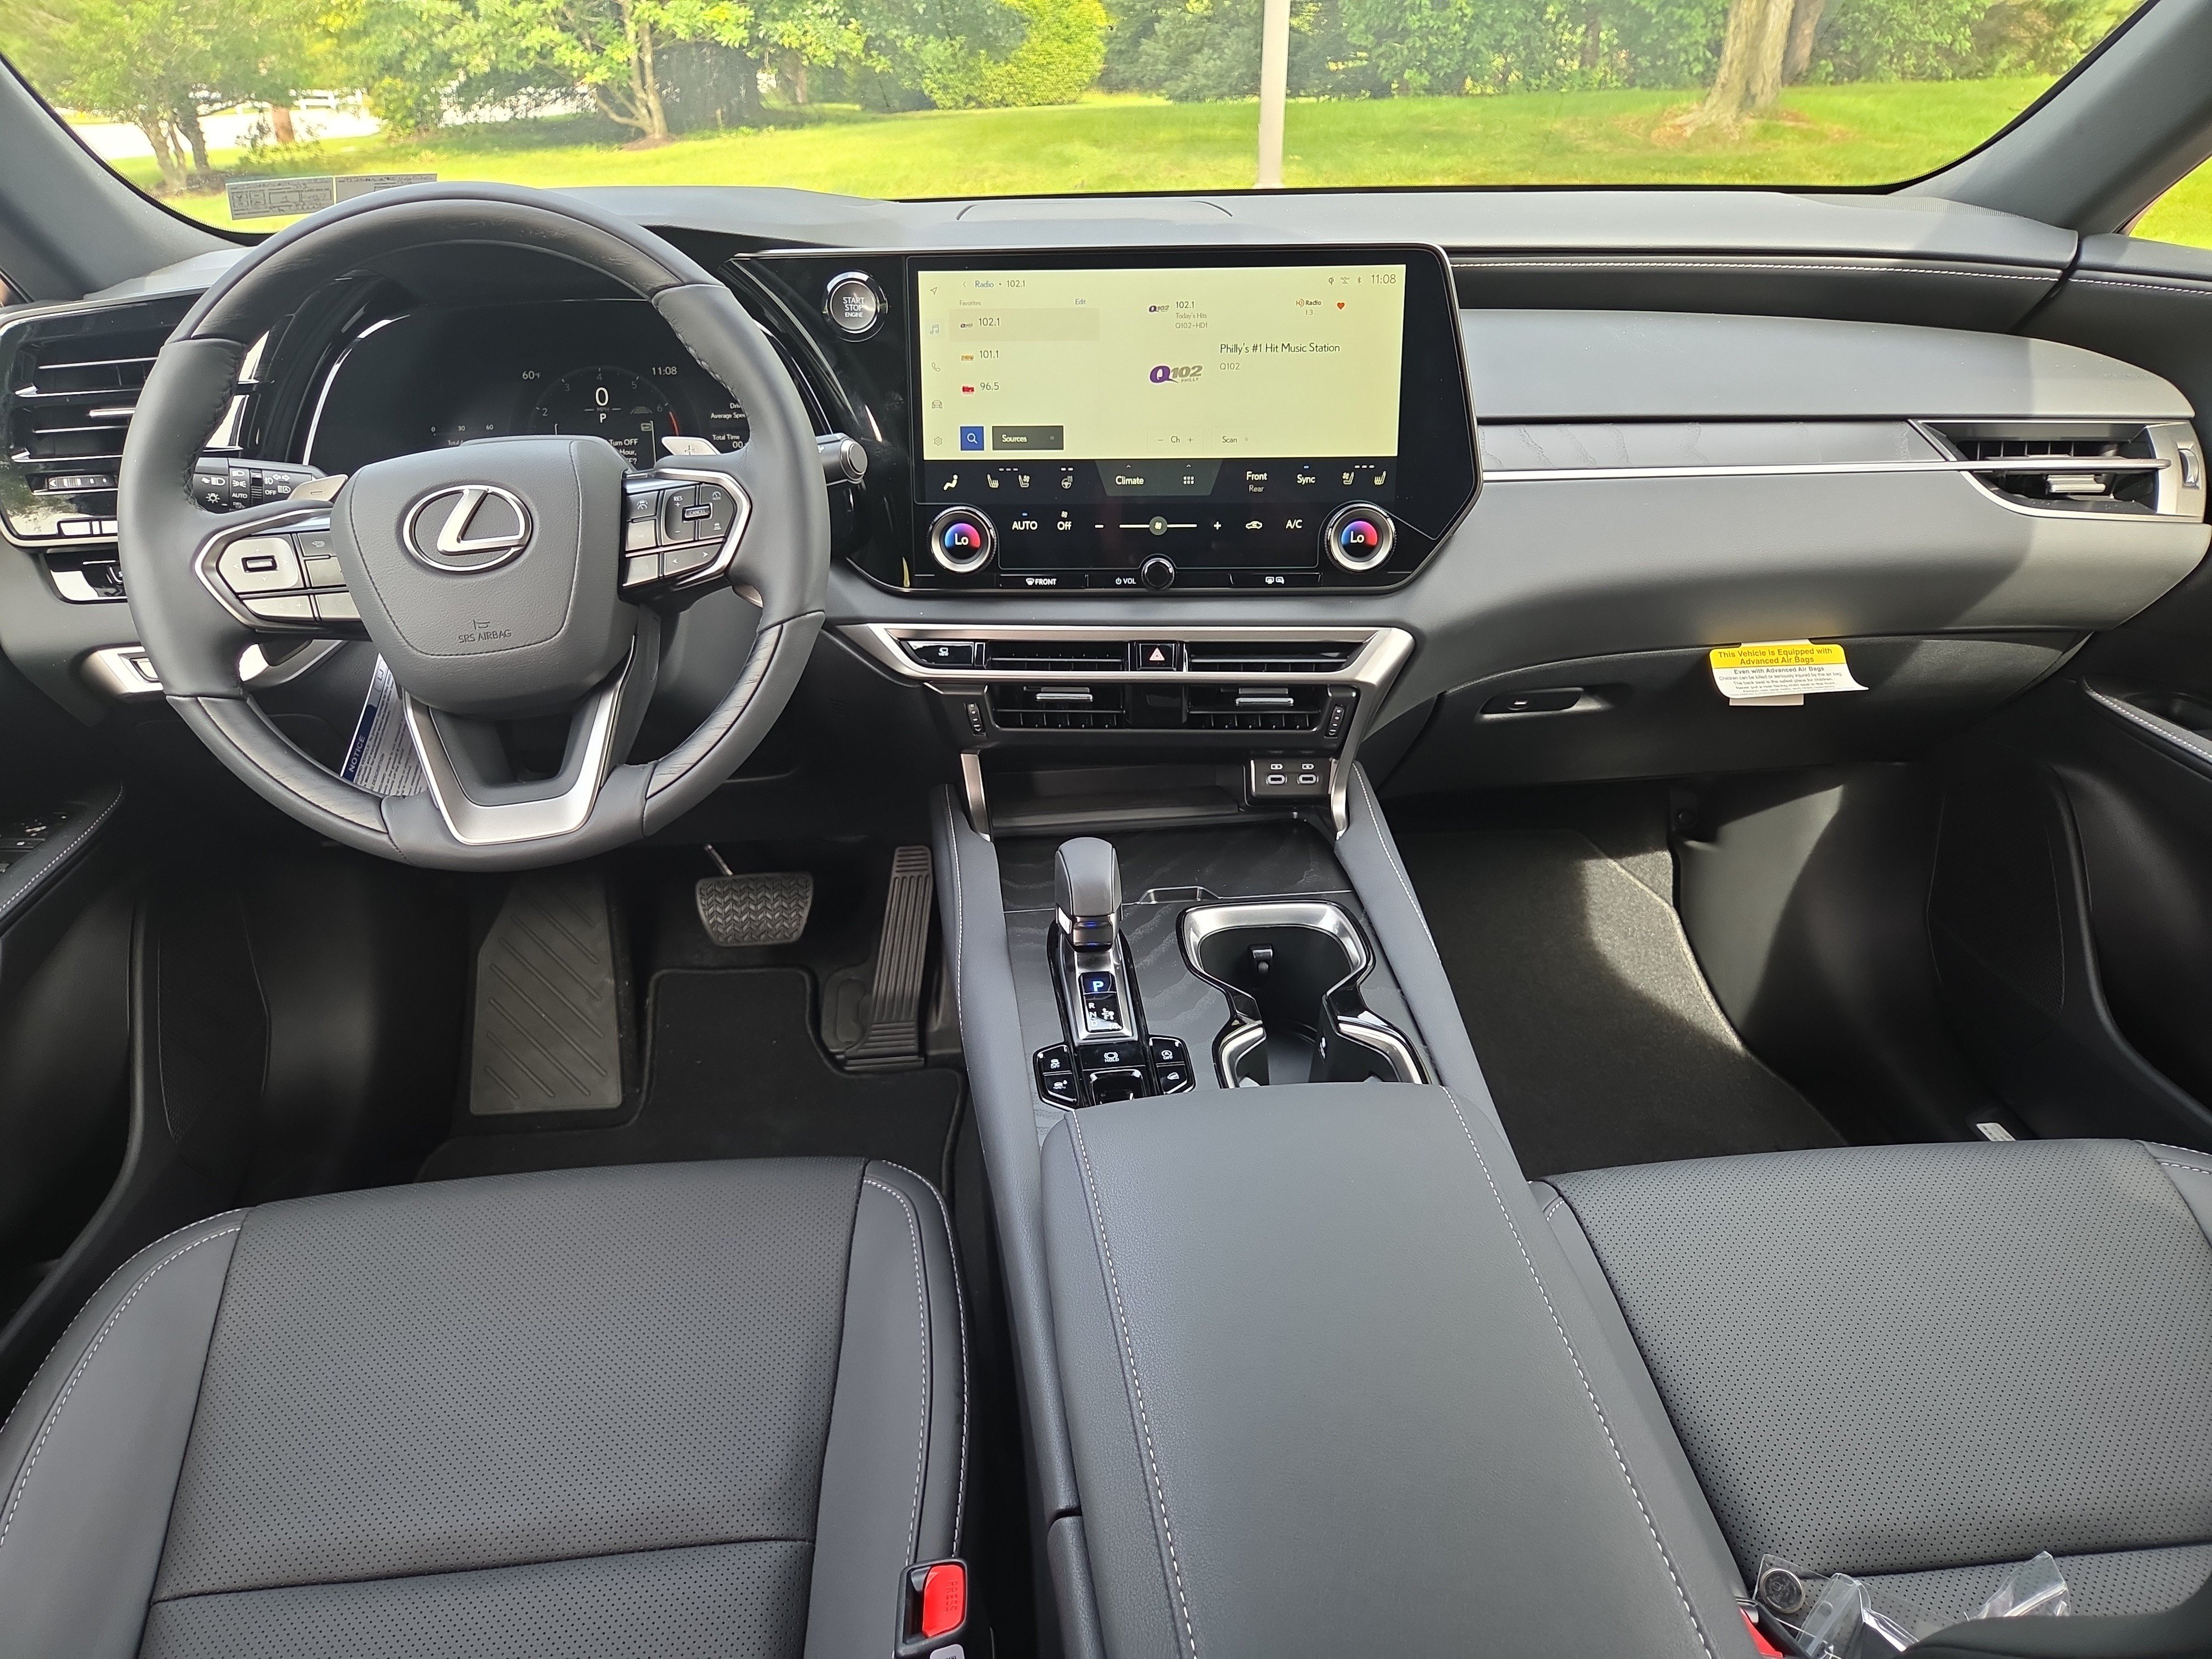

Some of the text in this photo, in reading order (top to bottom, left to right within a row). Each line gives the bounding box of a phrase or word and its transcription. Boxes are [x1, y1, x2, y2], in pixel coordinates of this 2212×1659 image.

[1371, 274, 1396, 284] 11:08
[979, 317, 1000, 326] 102.1
[1220, 343, 1340, 355] Philly's #1 Hit Music Station
[980, 350, 999, 359] 101.1
[652, 366, 677, 376] 11:08
[1149, 365, 1203, 383] Q102
[564, 383, 570, 391] 3
[632, 381, 638, 389] 5
[980, 382, 999, 391] 96.5
[595, 387, 609, 406] 0
[542, 408, 548, 416] 2
[657, 404, 663, 412] 6
[600, 413, 607, 423] P
[1002, 434, 1027, 442] Sources
[1115, 475, 1144, 485] Climate
[1246, 471, 1268, 481] Front
[1297, 474, 1316, 485] Sync
[1012, 520, 1038, 531] AUTO
[1057, 520, 1072, 531] Off
[1285, 519, 1303, 529] A/C
[954, 533, 969, 546] Lo
[1349, 531, 1365, 543] Lo
[458, 629, 512, 644] SRS AIRBAG
[1778, 648, 1815, 658] Equipped
[1740, 657, 1779, 665] Advanced
[1795, 656, 1815, 665] Bags
[348, 734, 366, 773] NOTICE
[1092, 981, 1104, 992] P
[946, 1579, 958, 1612] PRESS
